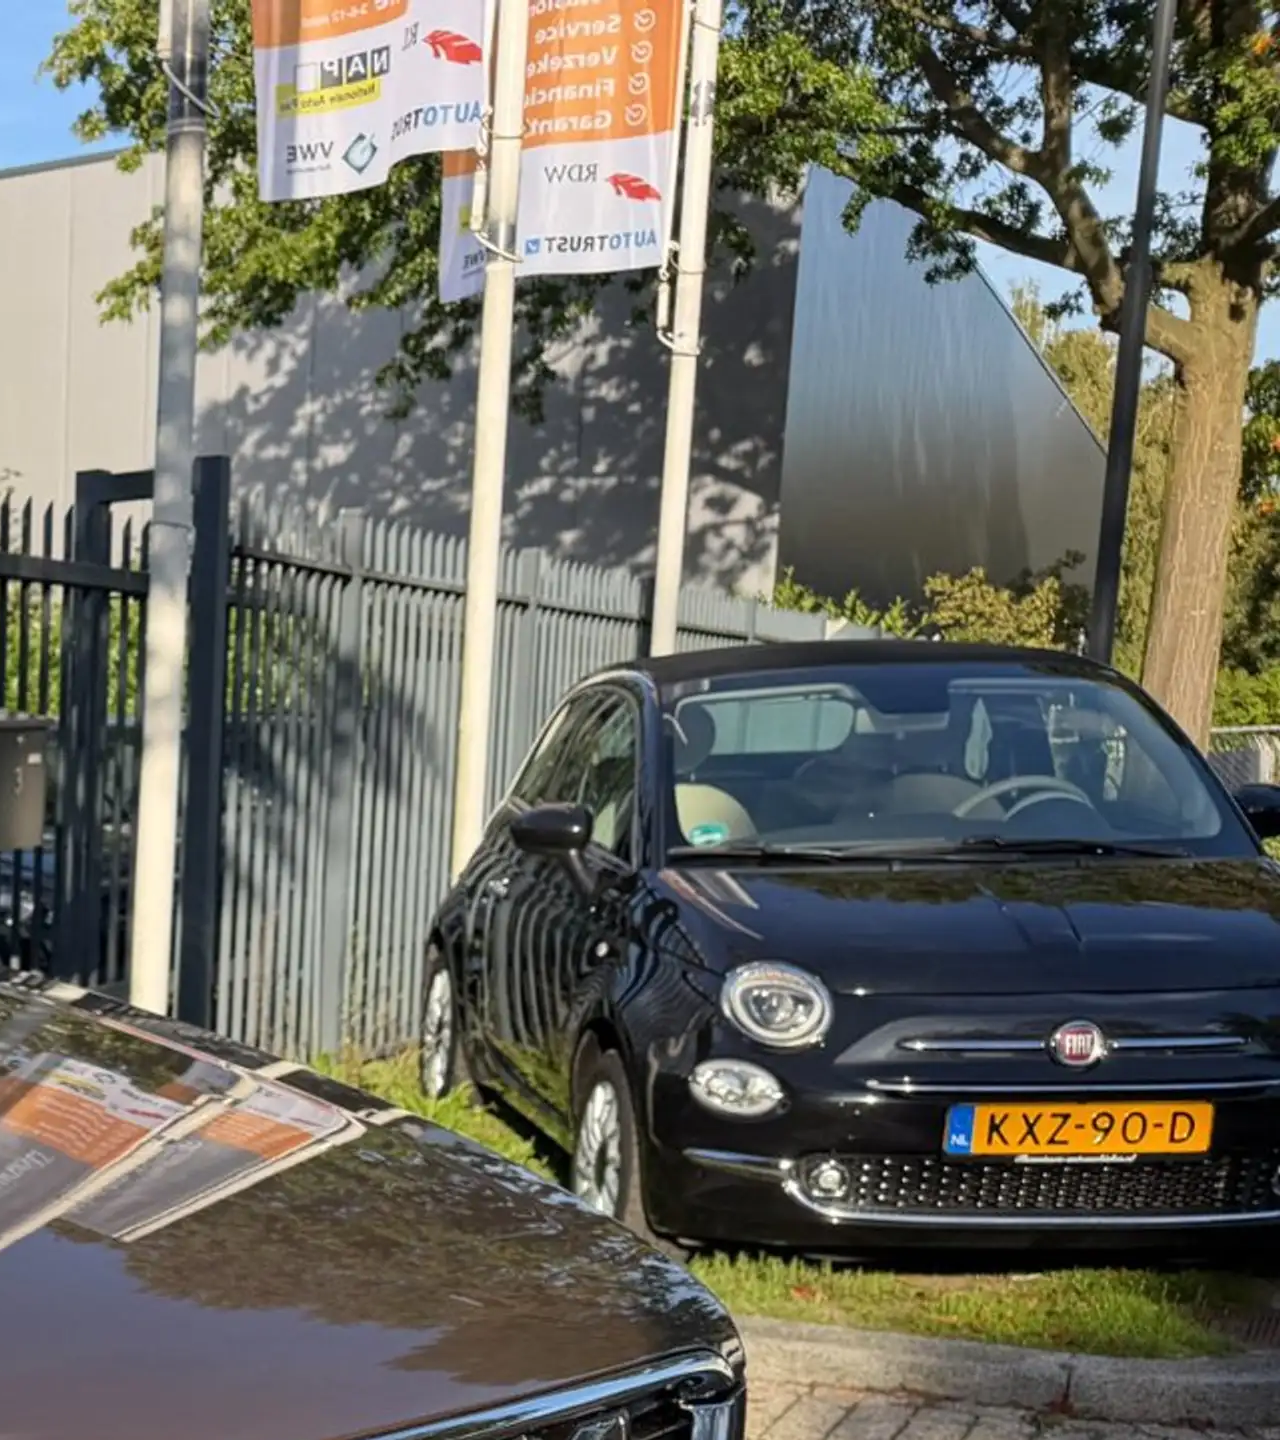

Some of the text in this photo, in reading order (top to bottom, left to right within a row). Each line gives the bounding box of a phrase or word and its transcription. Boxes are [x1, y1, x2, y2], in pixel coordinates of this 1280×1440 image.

[1065, 1033, 1093, 1056] FIAT
[986, 1110, 1196, 1147] KXZ-90-D
[950, 1134, 970, 1147] NL
